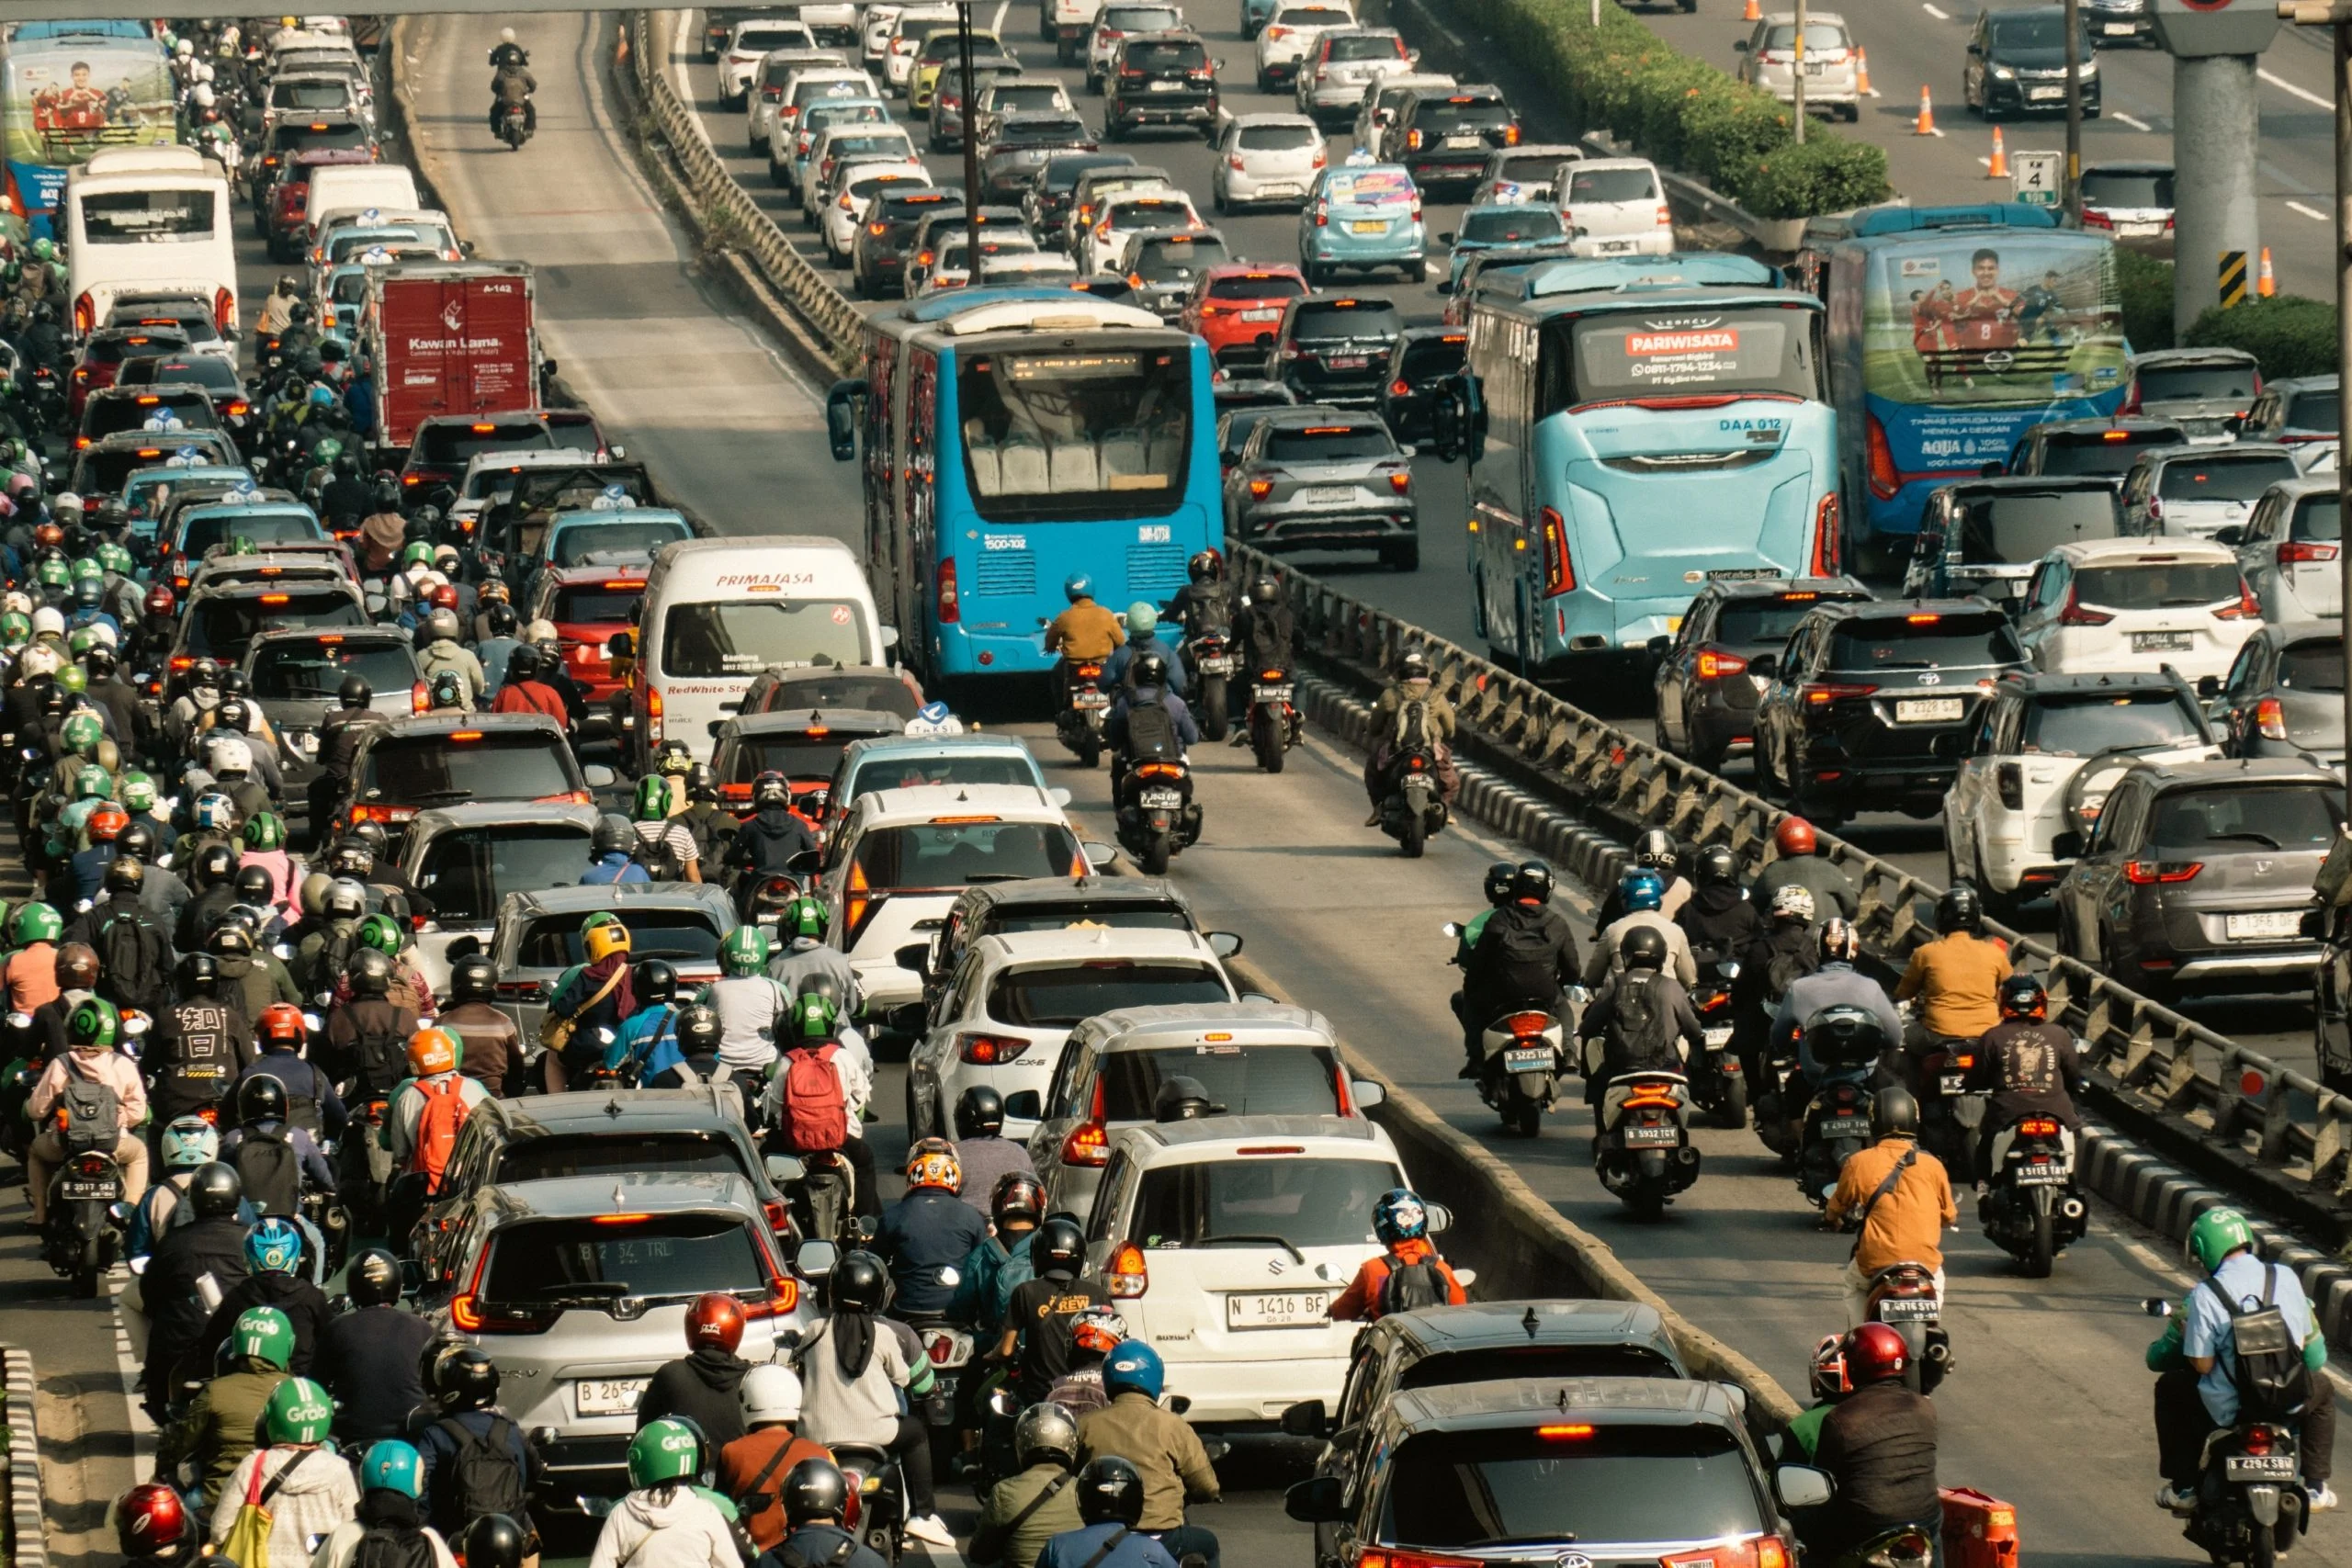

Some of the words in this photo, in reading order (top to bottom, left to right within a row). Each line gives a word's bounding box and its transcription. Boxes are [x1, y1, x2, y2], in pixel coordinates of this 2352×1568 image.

[2028, 173, 2041, 187] 4
[483, 285, 513, 294] A-142
[459, 337, 499, 348] Lama
[1633, 333, 1734, 352] PARIWISATA
[1720, 419, 1752, 431] DAA
[1758, 419, 1781, 430] 012
[1922, 427, 1968, 435] MENYALA
[1921, 440, 1961, 457] AQUA
[984, 539, 1026, 550] 1500-102
[717, 573, 814, 587] PRIMAJASA
[668, 684, 724, 695] RedWhite
[731, 951, 760, 964] Grab
[1516, 1050, 1537, 1060] 5225
[2044, 1044, 2056, 1070] MIND
[1015, 1058, 1047, 1066] CX-5
[1628, 1130, 1634, 1139] B
[1638, 1129, 1657, 1138] 5932
[74, 1183, 95, 1191] 3517
[645, 1241, 673, 1258] TRL
[1232, 1299, 1241, 1315] N
[1257, 1297, 1295, 1315] 1416
[1306, 1296, 1323, 1313] BF
[239, 1318, 279, 1336] Grab
[582, 1384, 592, 1401] B
[286, 1404, 328, 1423] Grab
[2231, 1460, 2237, 1469] B
[2243, 1459, 2269, 1469] 4294
